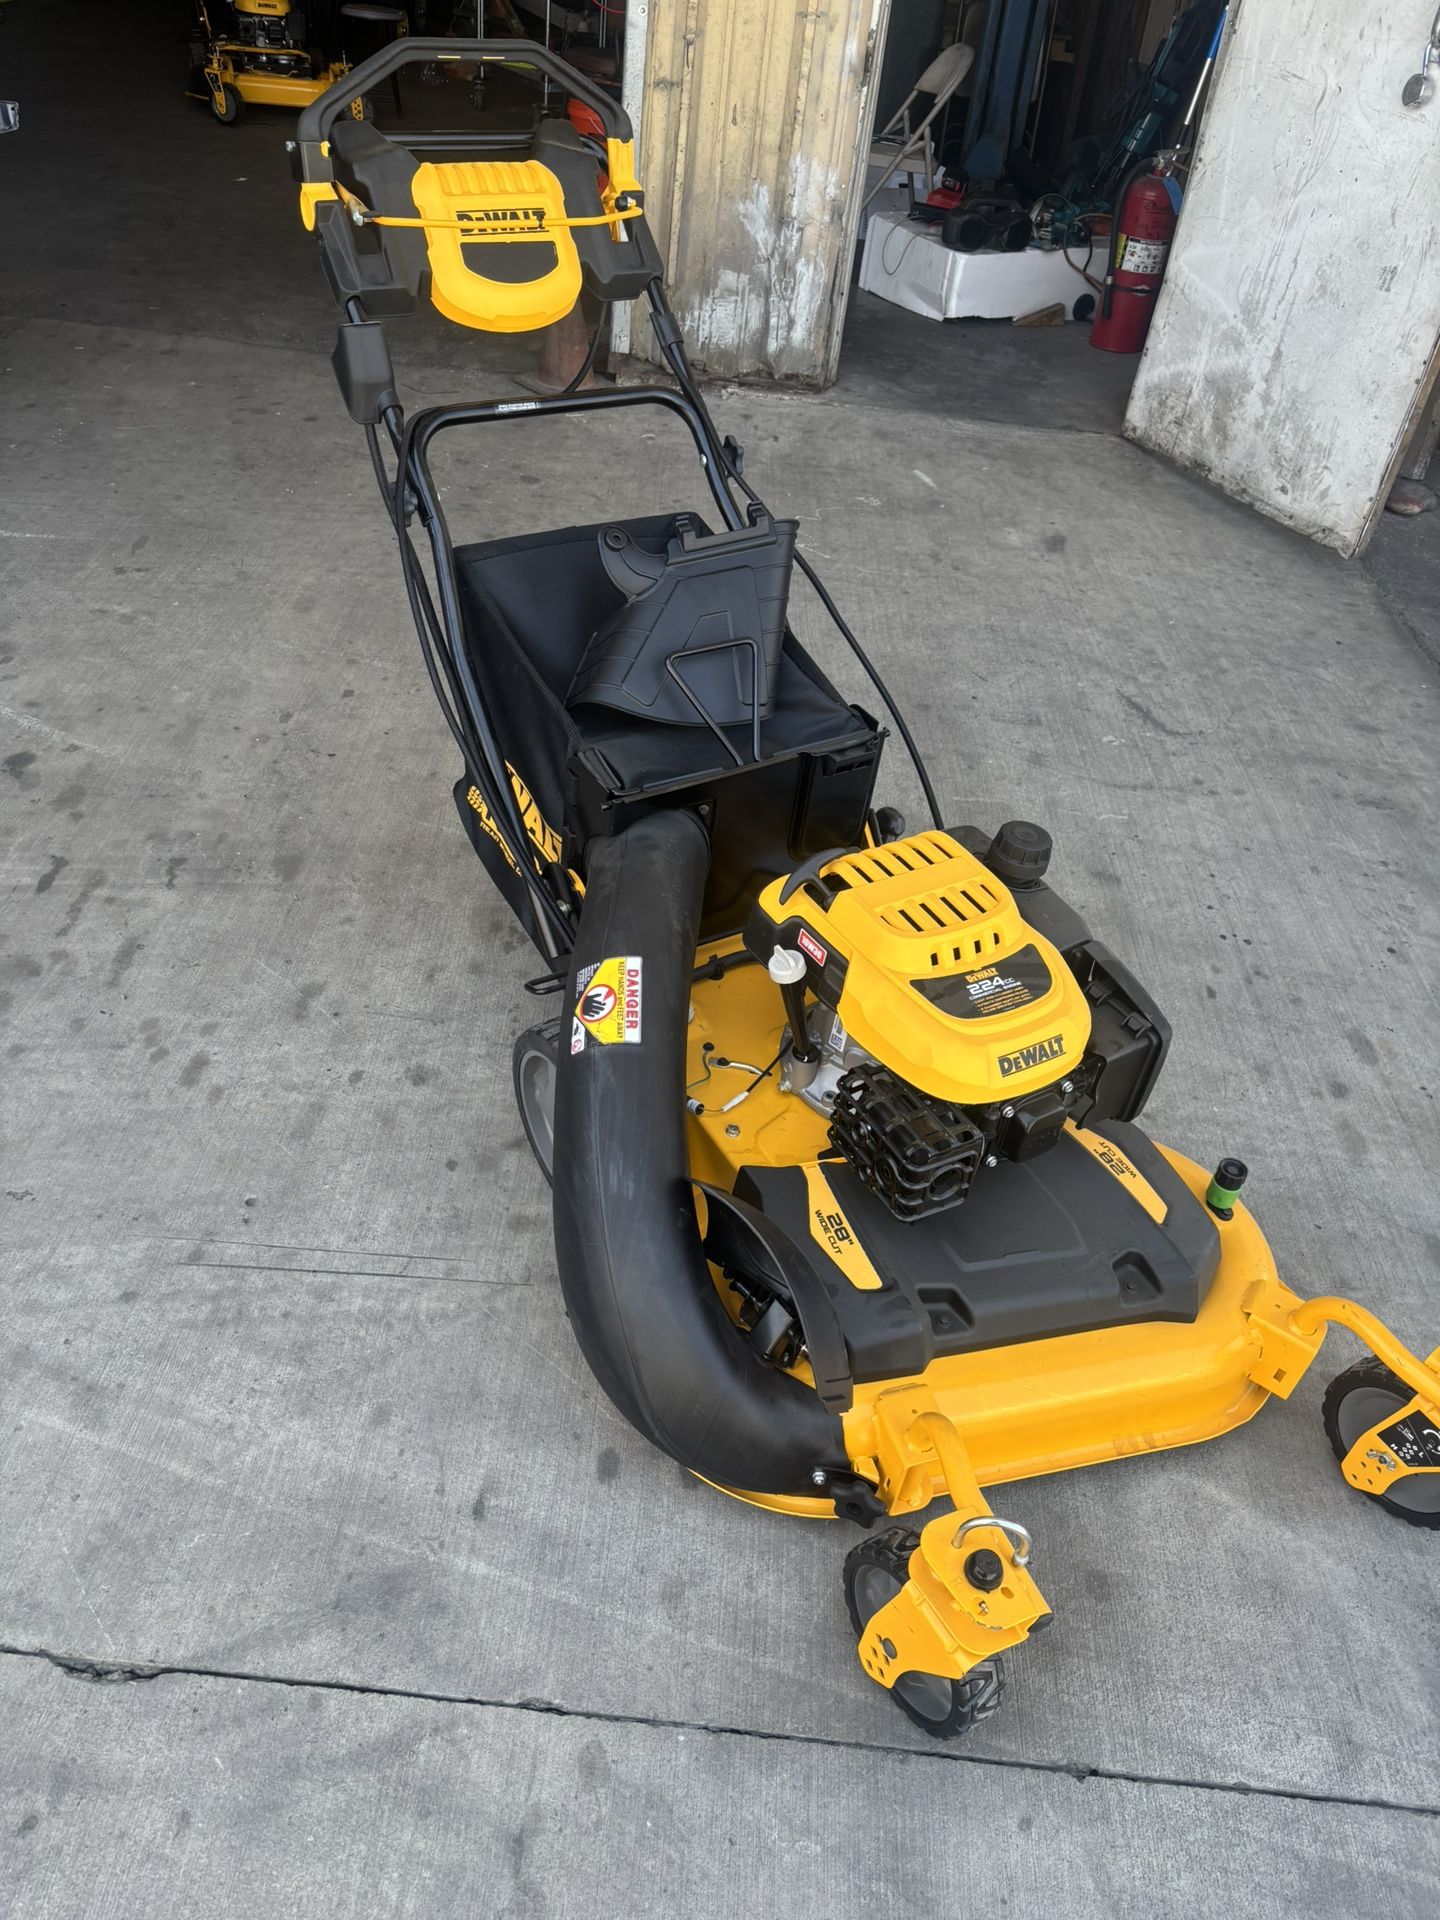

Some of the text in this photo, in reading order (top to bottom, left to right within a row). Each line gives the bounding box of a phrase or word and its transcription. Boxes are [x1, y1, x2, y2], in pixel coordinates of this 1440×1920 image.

[617, 961, 625, 977] KEEP
[616, 976, 625, 996] HANDS
[625, 968, 639, 1029] DANGER
[616, 1007, 625, 1021] FEET
[616, 1021, 625, 1039] AWAY
[1098, 1141, 1137, 1178] WIDE CUT
[815, 1210, 843, 1255] WIDE CUT
[826, 1212, 854, 1245] 28"
